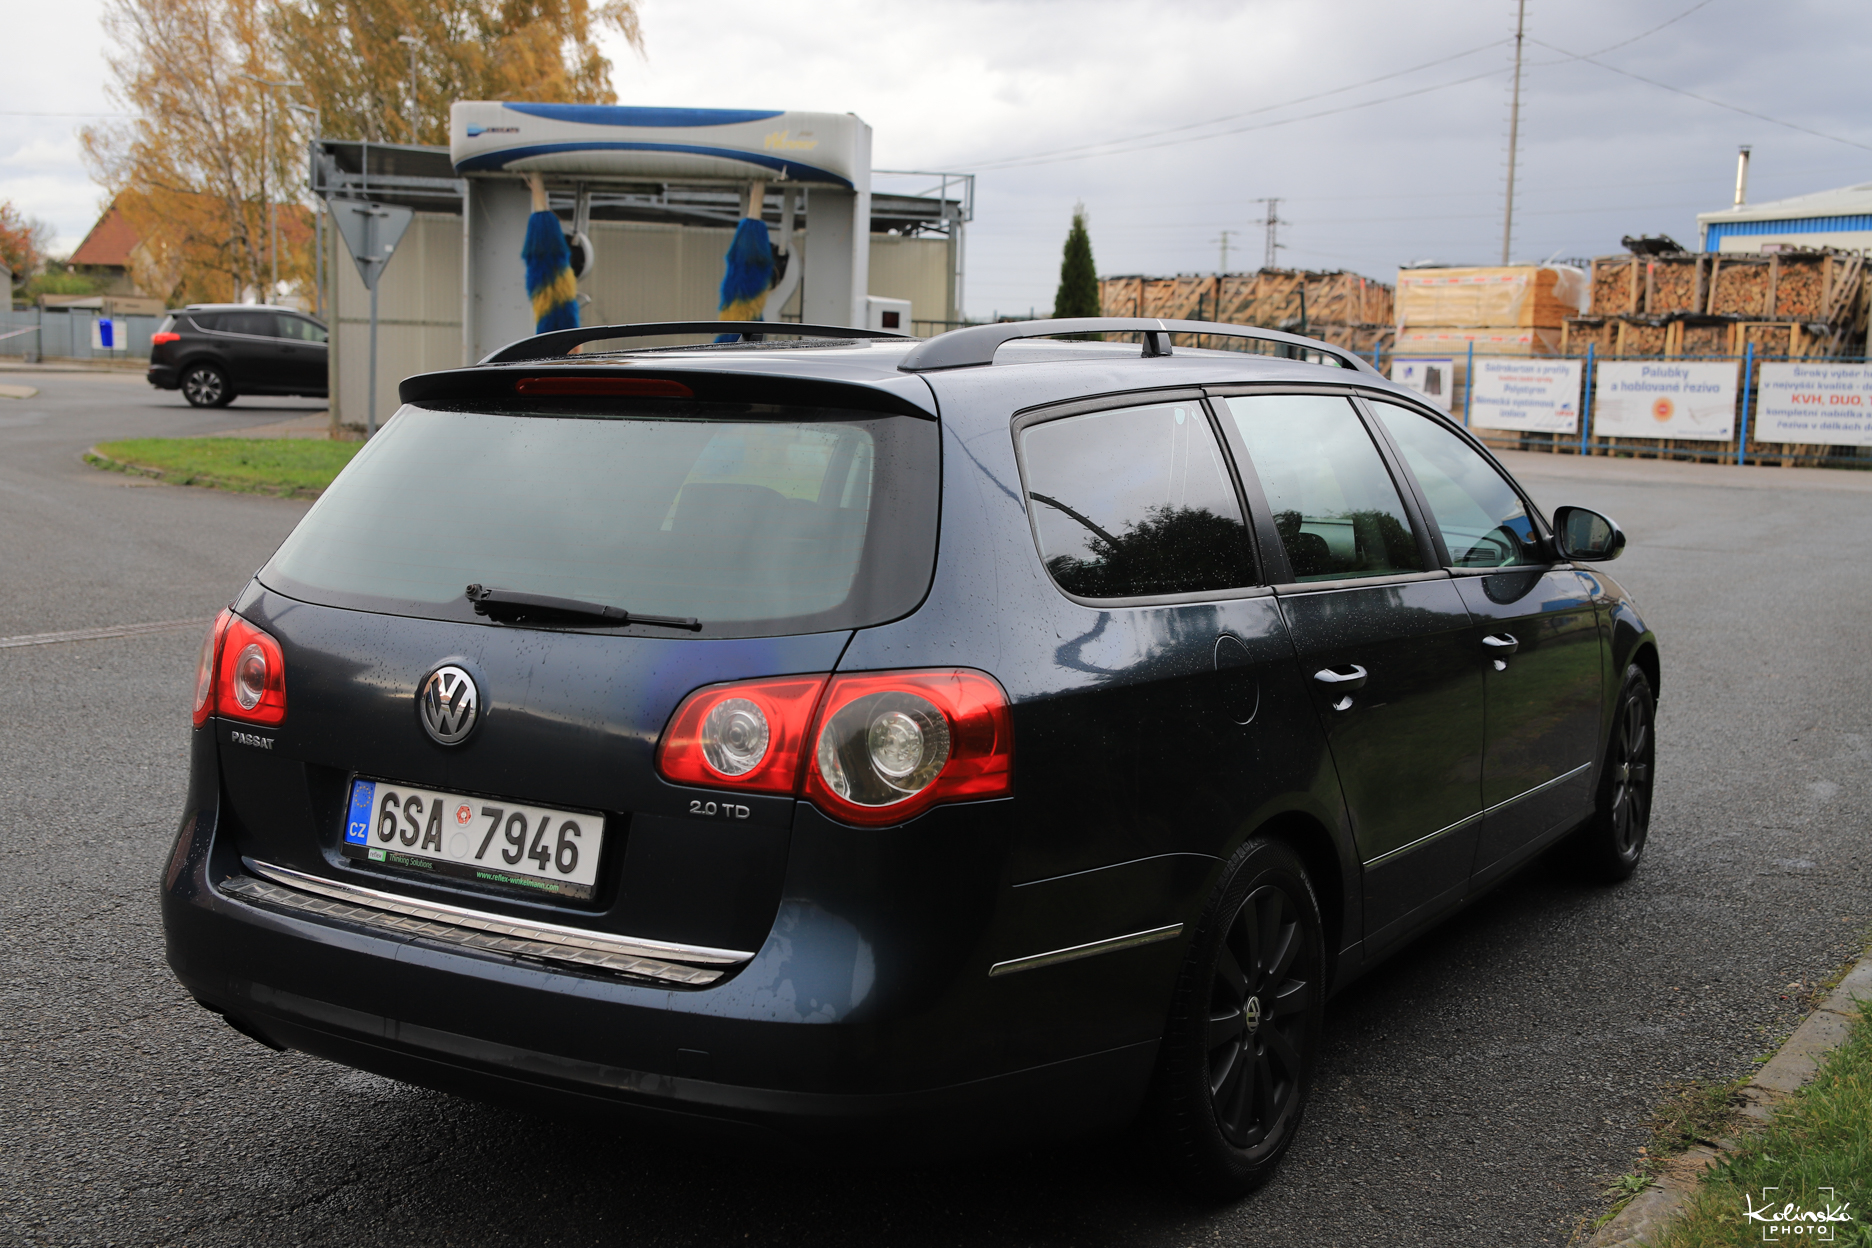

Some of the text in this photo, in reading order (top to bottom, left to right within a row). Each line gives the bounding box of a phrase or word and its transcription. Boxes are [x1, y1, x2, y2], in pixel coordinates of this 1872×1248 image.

[1642, 366, 1689, 379] Palubky
[1793, 367, 1828, 379] Široký
[1610, 381, 1720, 393] a hoblované řezivo
[1791, 393, 1826, 406] KVH,
[1829, 394, 1864, 407] DUO,
[231, 730, 275, 750] PASSAT
[689, 799, 751, 820] 2.0 TD
[349, 821, 367, 838] CZ
[377, 791, 581, 874] 6SA 7946
[389, 853, 410, 867] Thinking
[476, 870, 560, 892] www.reflex-winkelmann.com
